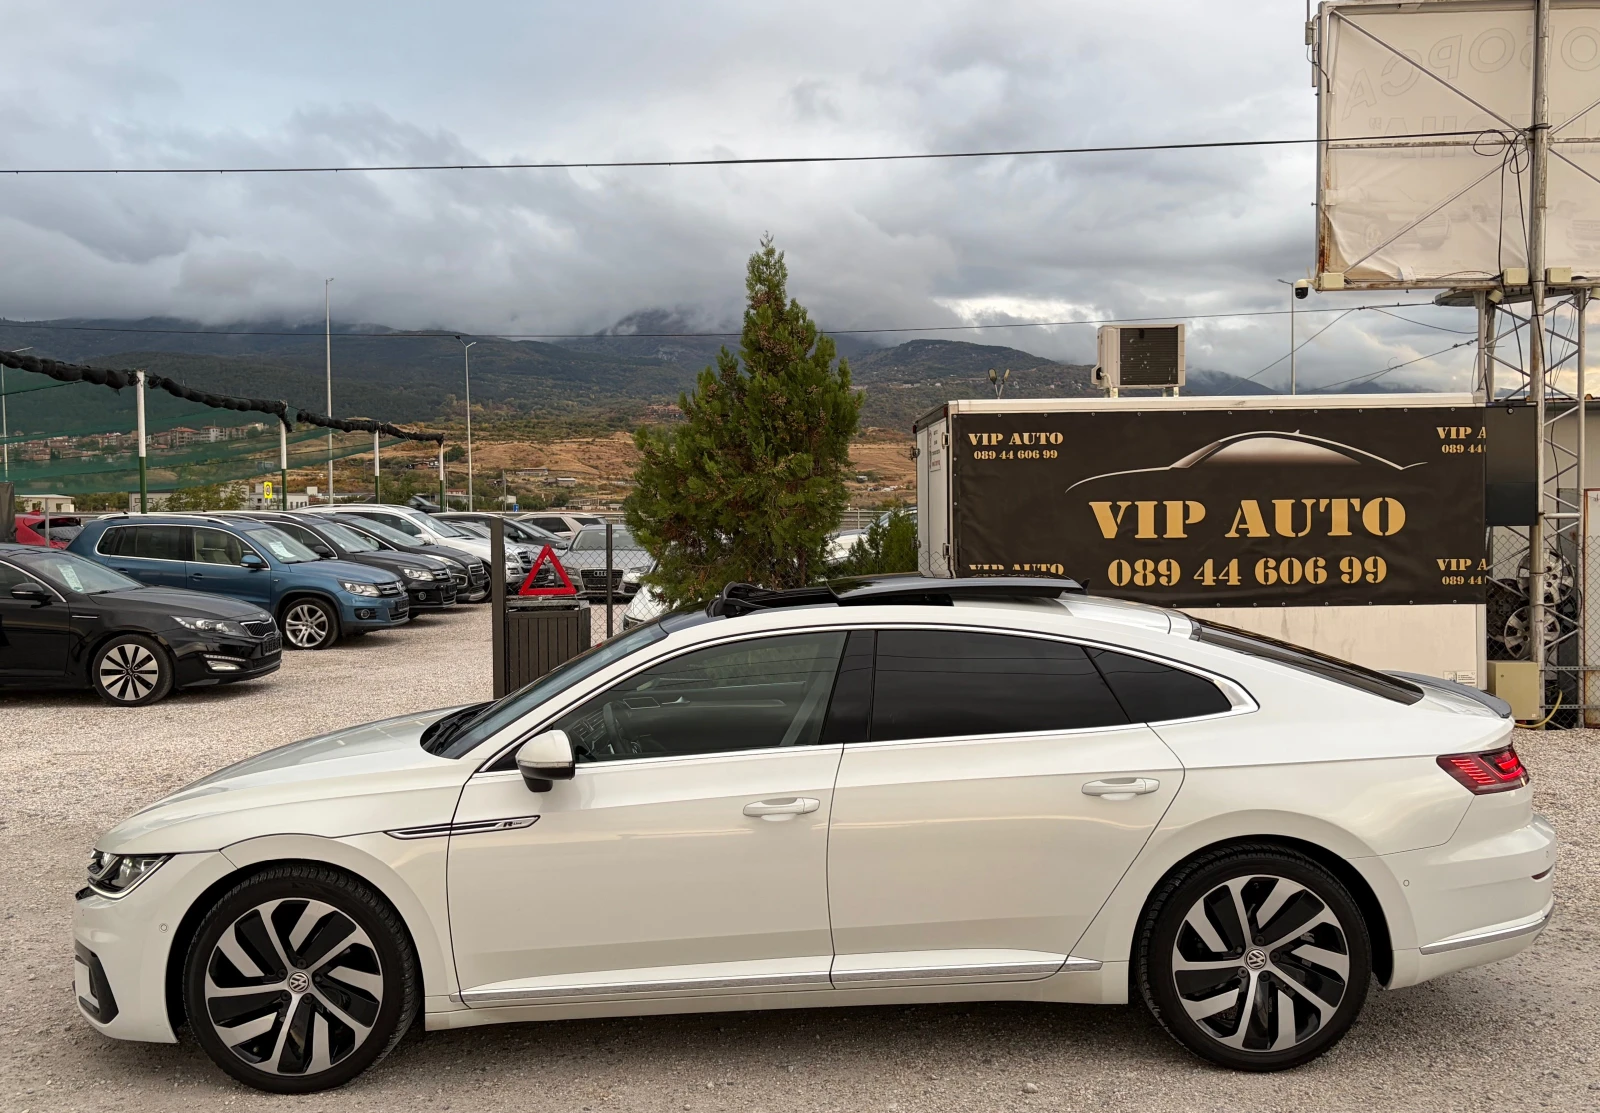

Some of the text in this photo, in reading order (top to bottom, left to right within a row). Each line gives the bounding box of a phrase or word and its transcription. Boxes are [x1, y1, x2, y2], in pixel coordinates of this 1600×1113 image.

[968, 432, 1064, 446] VIP AUTO
[1436, 426, 1472, 439] VIP
[973, 449, 1058, 460] 089 44 606 99
[1441, 444, 1465, 453] 089
[1468, 444, 1482, 453] 44
[1088, 497, 1406, 539] VIP AUTO
[1107, 555, 1388, 587] 089 44 606 99
[1436, 558, 1472, 571] VIP
[1441, 576, 1465, 585] 089
[1468, 576, 1482, 585] 44
